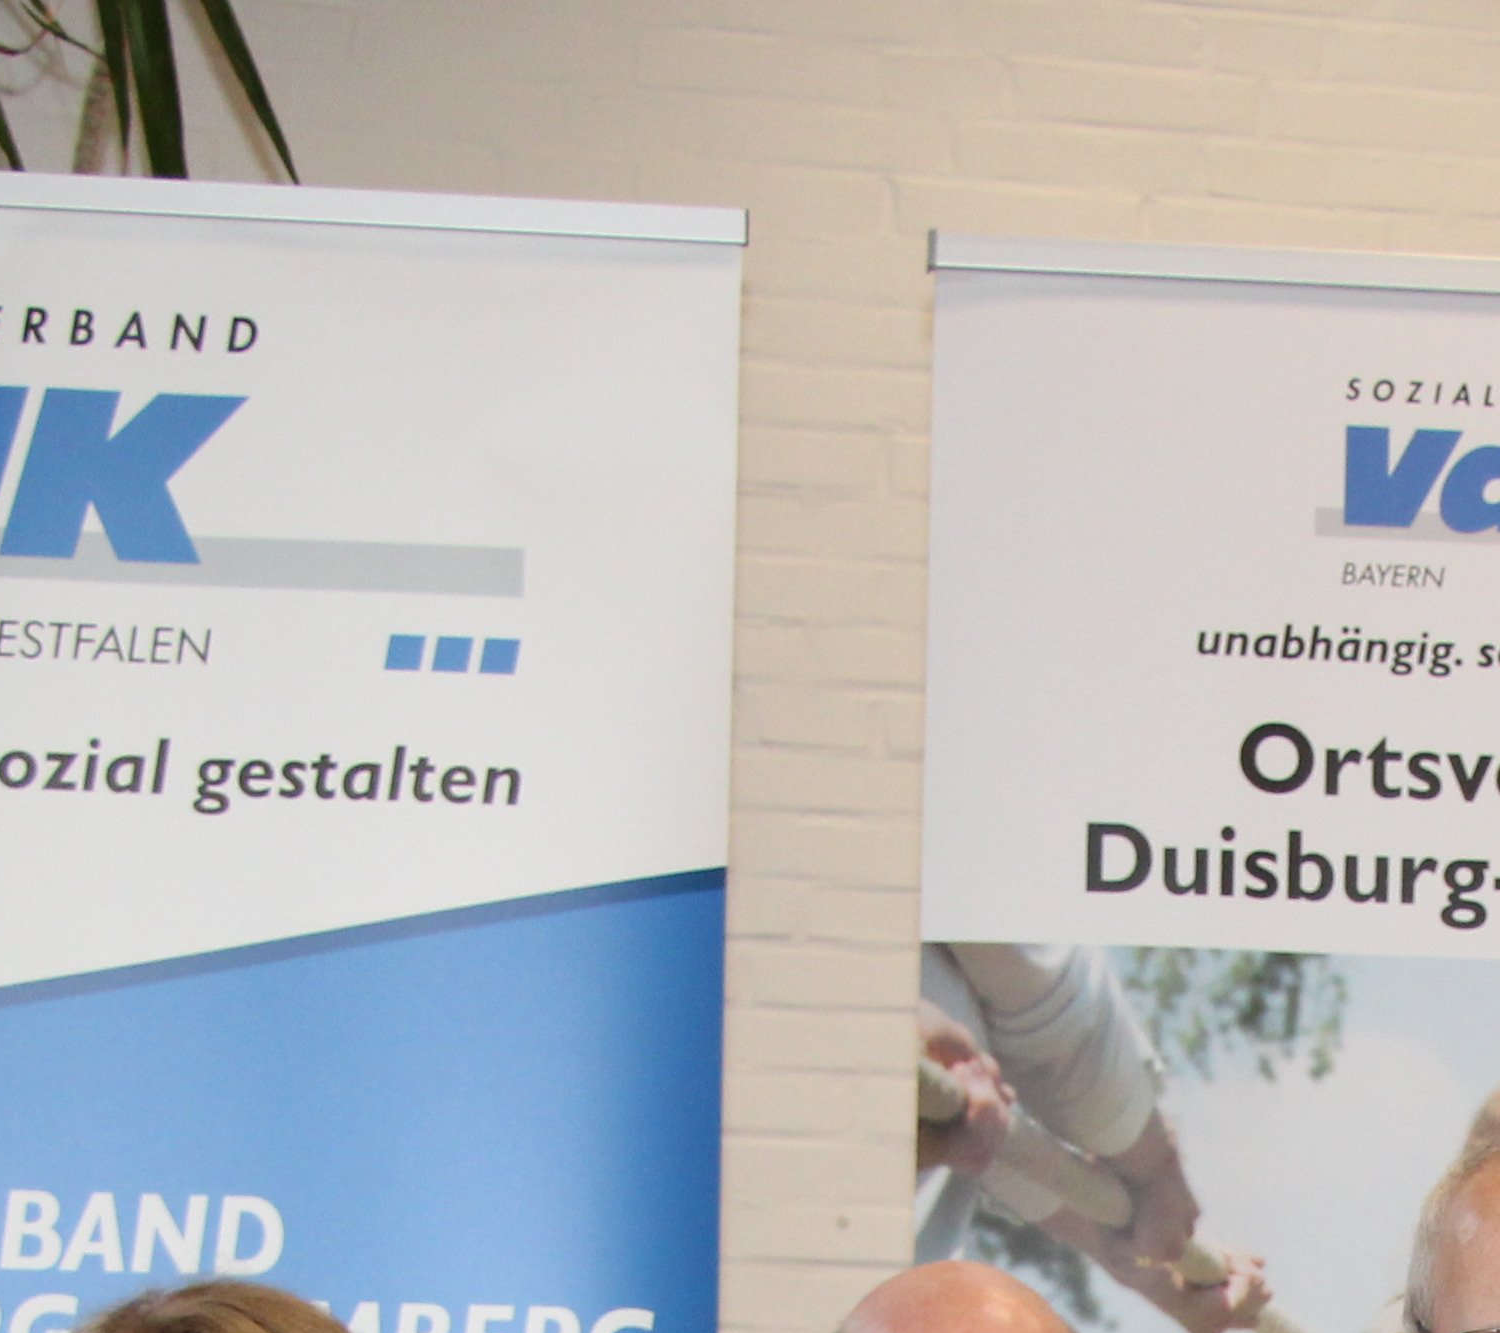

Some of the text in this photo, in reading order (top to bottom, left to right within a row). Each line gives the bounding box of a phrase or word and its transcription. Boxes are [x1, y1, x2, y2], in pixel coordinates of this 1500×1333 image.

[1343, 563, 1444, 587] BAYERN
[1197, 624, 1463, 676] unabhängig.
[193, 745, 520, 814] gestalten
